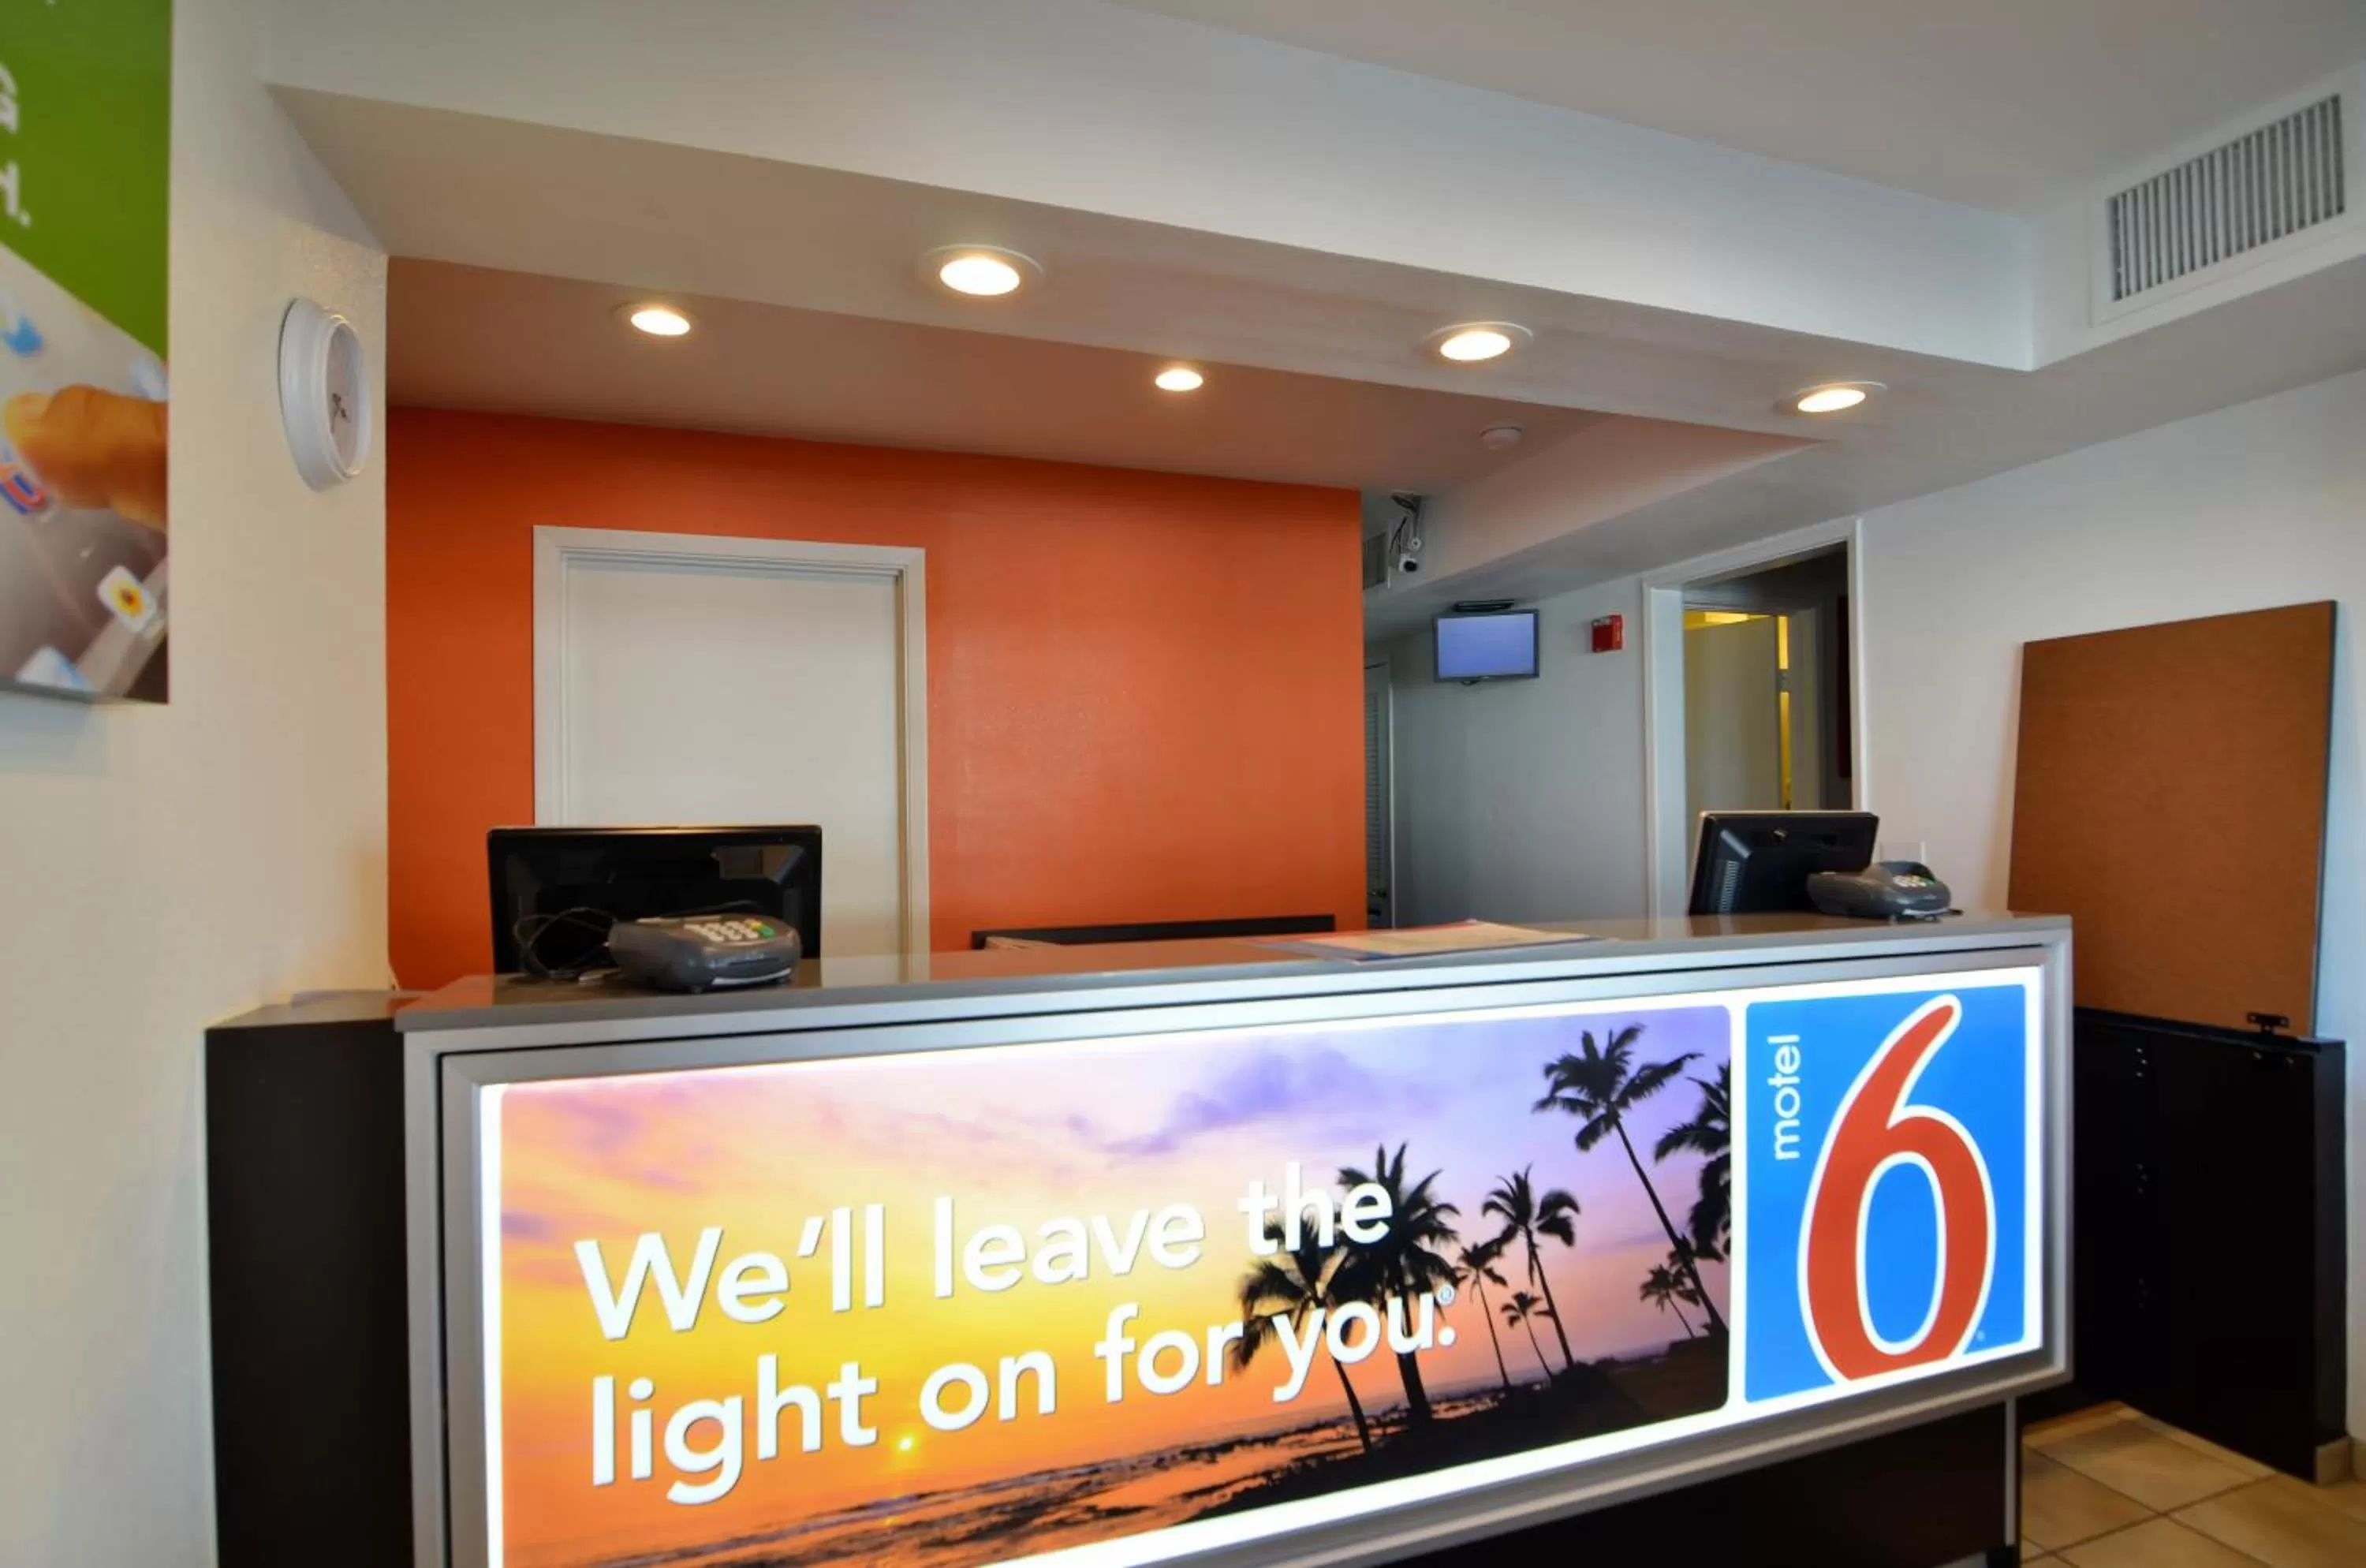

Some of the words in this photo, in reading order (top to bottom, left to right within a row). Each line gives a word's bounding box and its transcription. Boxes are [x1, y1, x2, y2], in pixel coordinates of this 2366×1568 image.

[573, 1203, 885, 1342] We’ll
[934, 1195, 1204, 1298] leave
[1237, 1161, 1393, 1257] the
[1767, 1034, 1801, 1161] motel
[1797, 993, 1996, 1385] 6
[592, 1352, 878, 1505] light
[918, 1348, 1057, 1432] on
[1094, 1302, 1244, 1402] for
